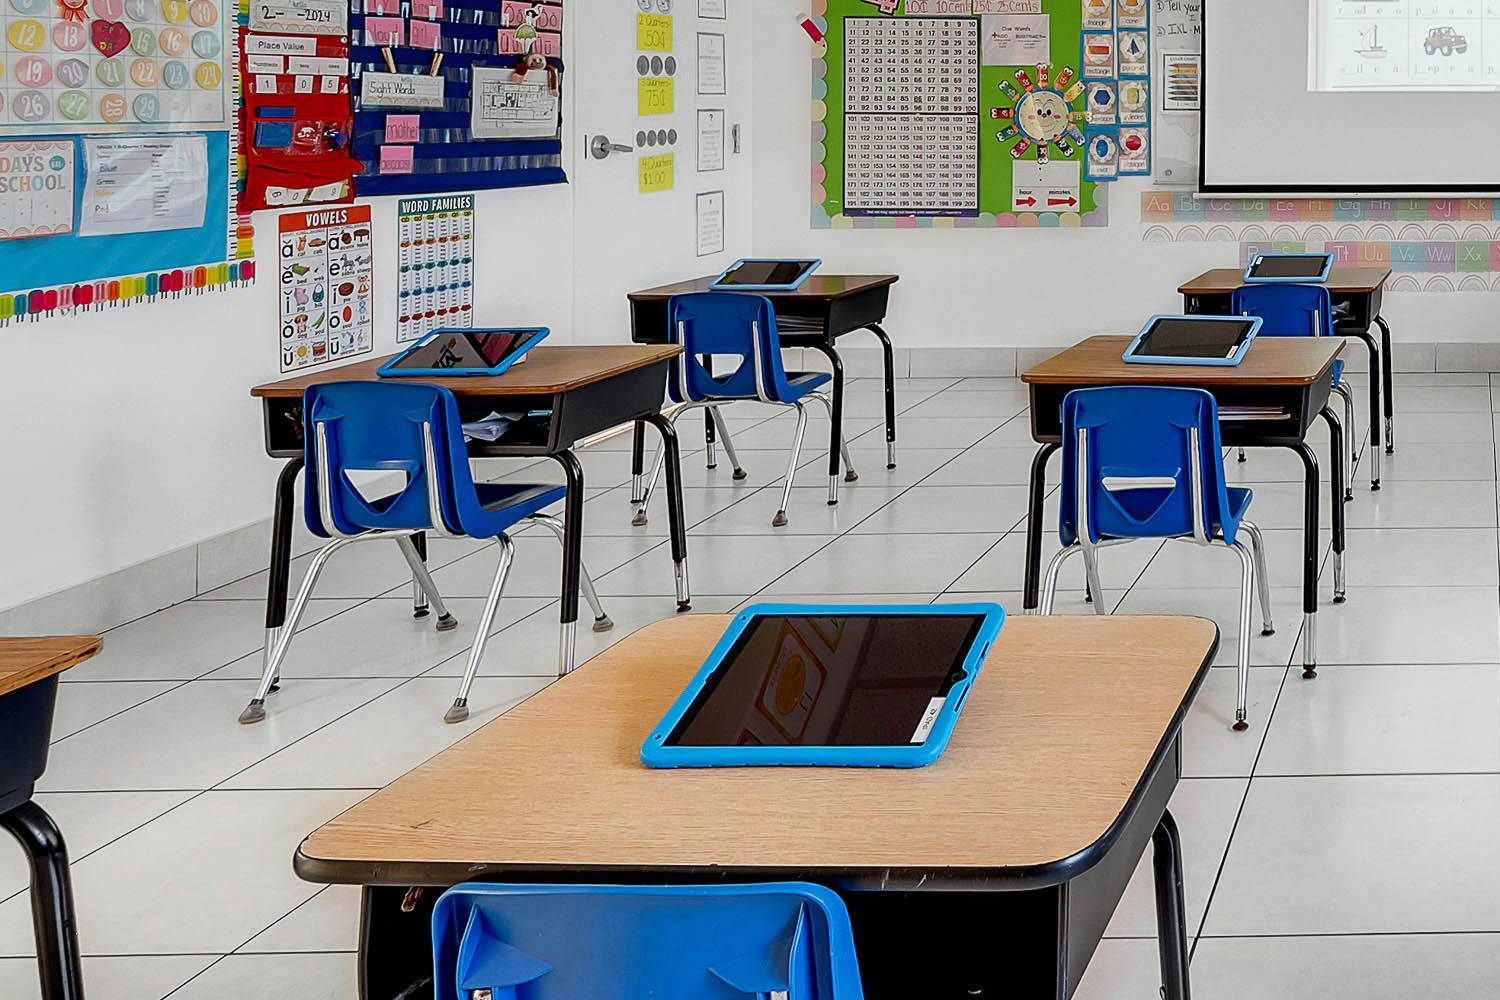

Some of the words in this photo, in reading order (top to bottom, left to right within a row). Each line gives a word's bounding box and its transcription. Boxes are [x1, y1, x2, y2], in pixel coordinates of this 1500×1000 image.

[169, 1, 179, 20] 9
[199, 2, 213, 21] 10
[1164, 0, 1182, 12] Tell
[18, 25, 36, 47] 12
[63, 27, 79, 46] 13
[136, 33, 148, 50] 15
[166, 32, 180, 50] 16
[258, 40, 281, 51] Place
[283, 42, 305, 52] Value
[27, 59, 42, 83] 19
[62, 64, 83, 83] 20
[103, 63, 120, 83] 21
[137, 63, 155, 82] 22
[168, 66, 184, 84] 23
[202, 66, 217, 85] 24
[264, 79, 270, 88] 1
[301, 79, 307, 89] 0
[369, 81, 393, 98] Sight
[394, 84, 416, 96] Words
[22, 95, 44, 117] 26
[105, 98, 124, 117] 28
[140, 98, 156, 118] 29
[401, 199, 429, 213] WORD
[431, 196, 472, 211] FAMILIES
[1146, 195, 1171, 212] Aa
[305, 209, 348, 227] VOWELS
[1364, 246, 1384, 262] Uu
[1427, 246, 1451, 262] Ww
[1463, 246, 1482, 262] Xx
